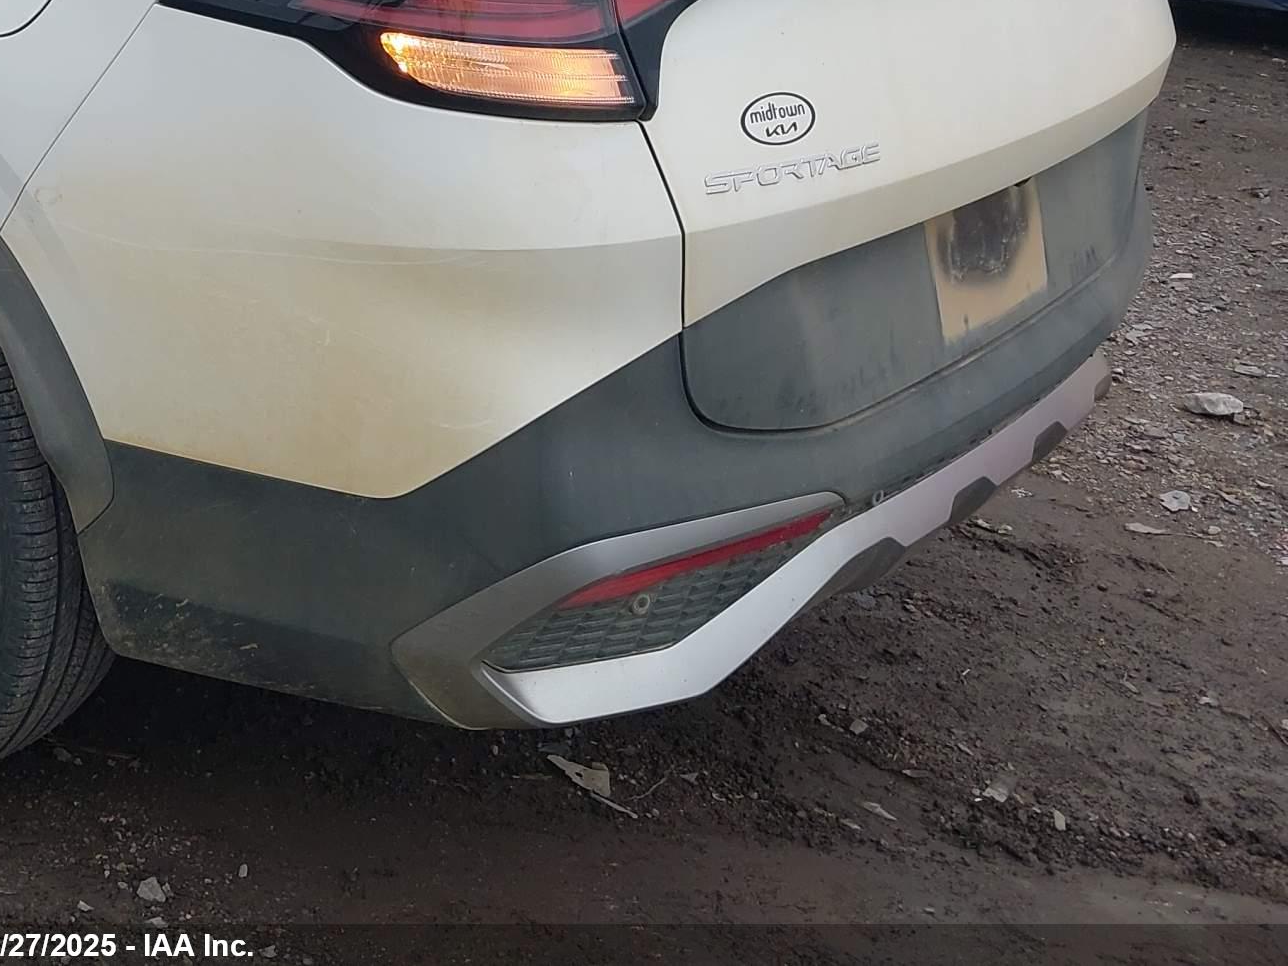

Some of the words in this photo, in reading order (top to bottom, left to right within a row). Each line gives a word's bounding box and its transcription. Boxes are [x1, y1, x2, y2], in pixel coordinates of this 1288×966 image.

[749, 102, 806, 124] midtown
[765, 121, 798, 138] KIA
[704, 144, 881, 195] SPORTAGE
